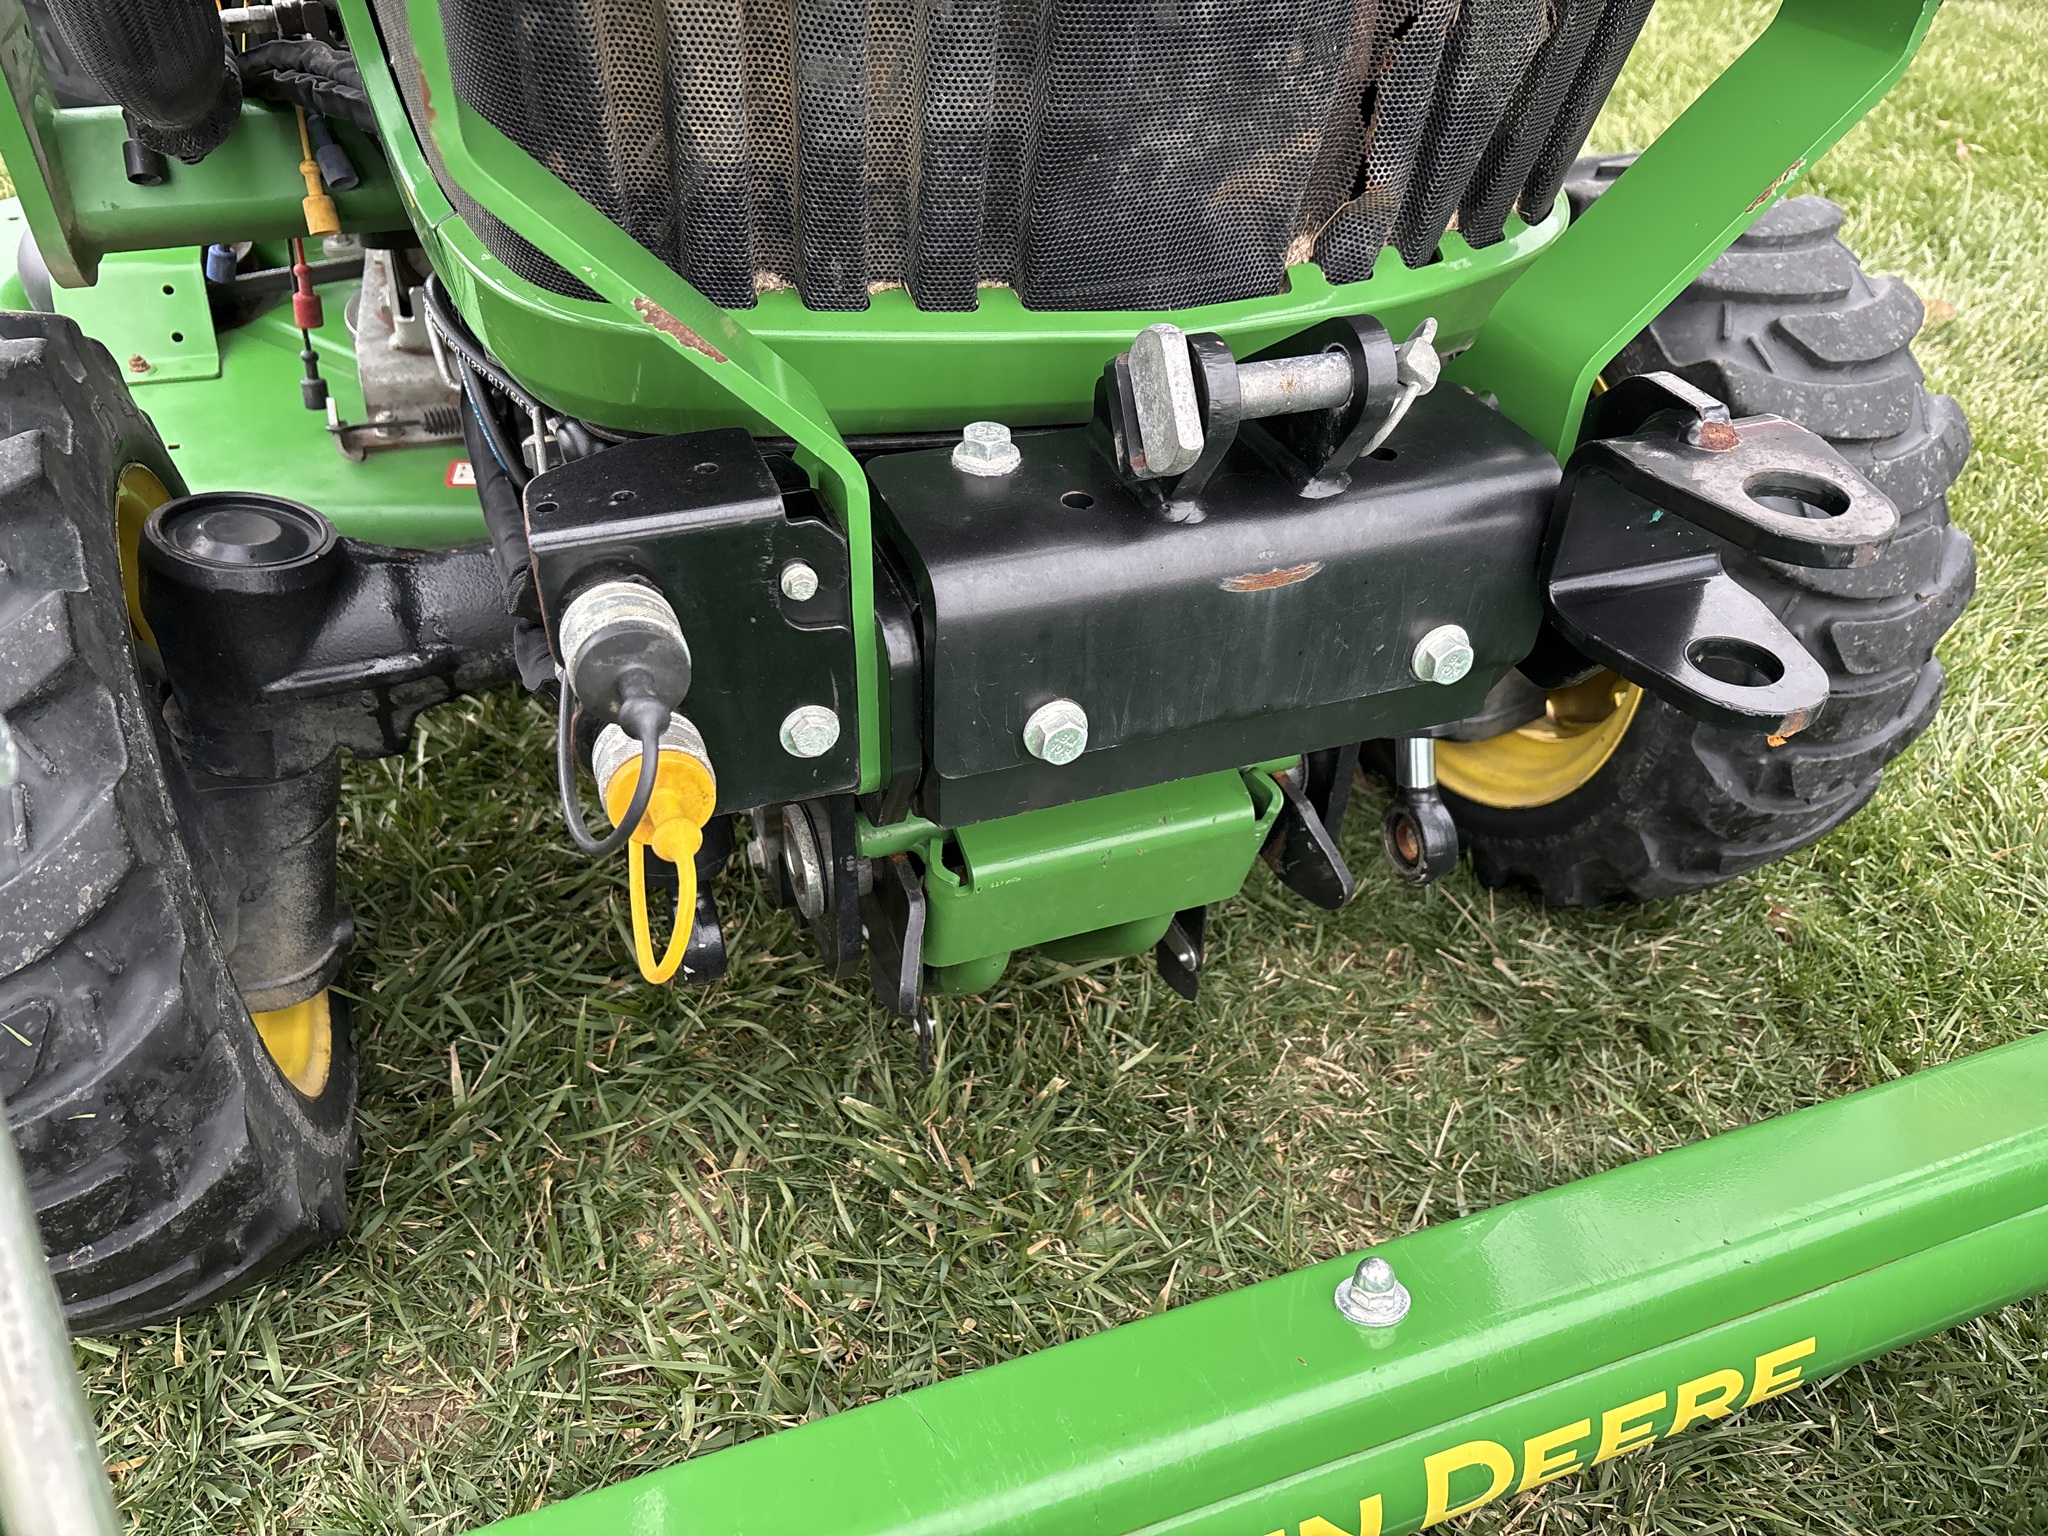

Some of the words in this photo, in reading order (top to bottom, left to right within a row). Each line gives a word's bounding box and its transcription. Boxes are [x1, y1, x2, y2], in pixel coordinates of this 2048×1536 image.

[461, 352, 487, 377] 11237
[488, 373, 505, 390] R17
[510, 391, 525, 409] SAE
[1420, 1336, 1816, 1530] DEERE
